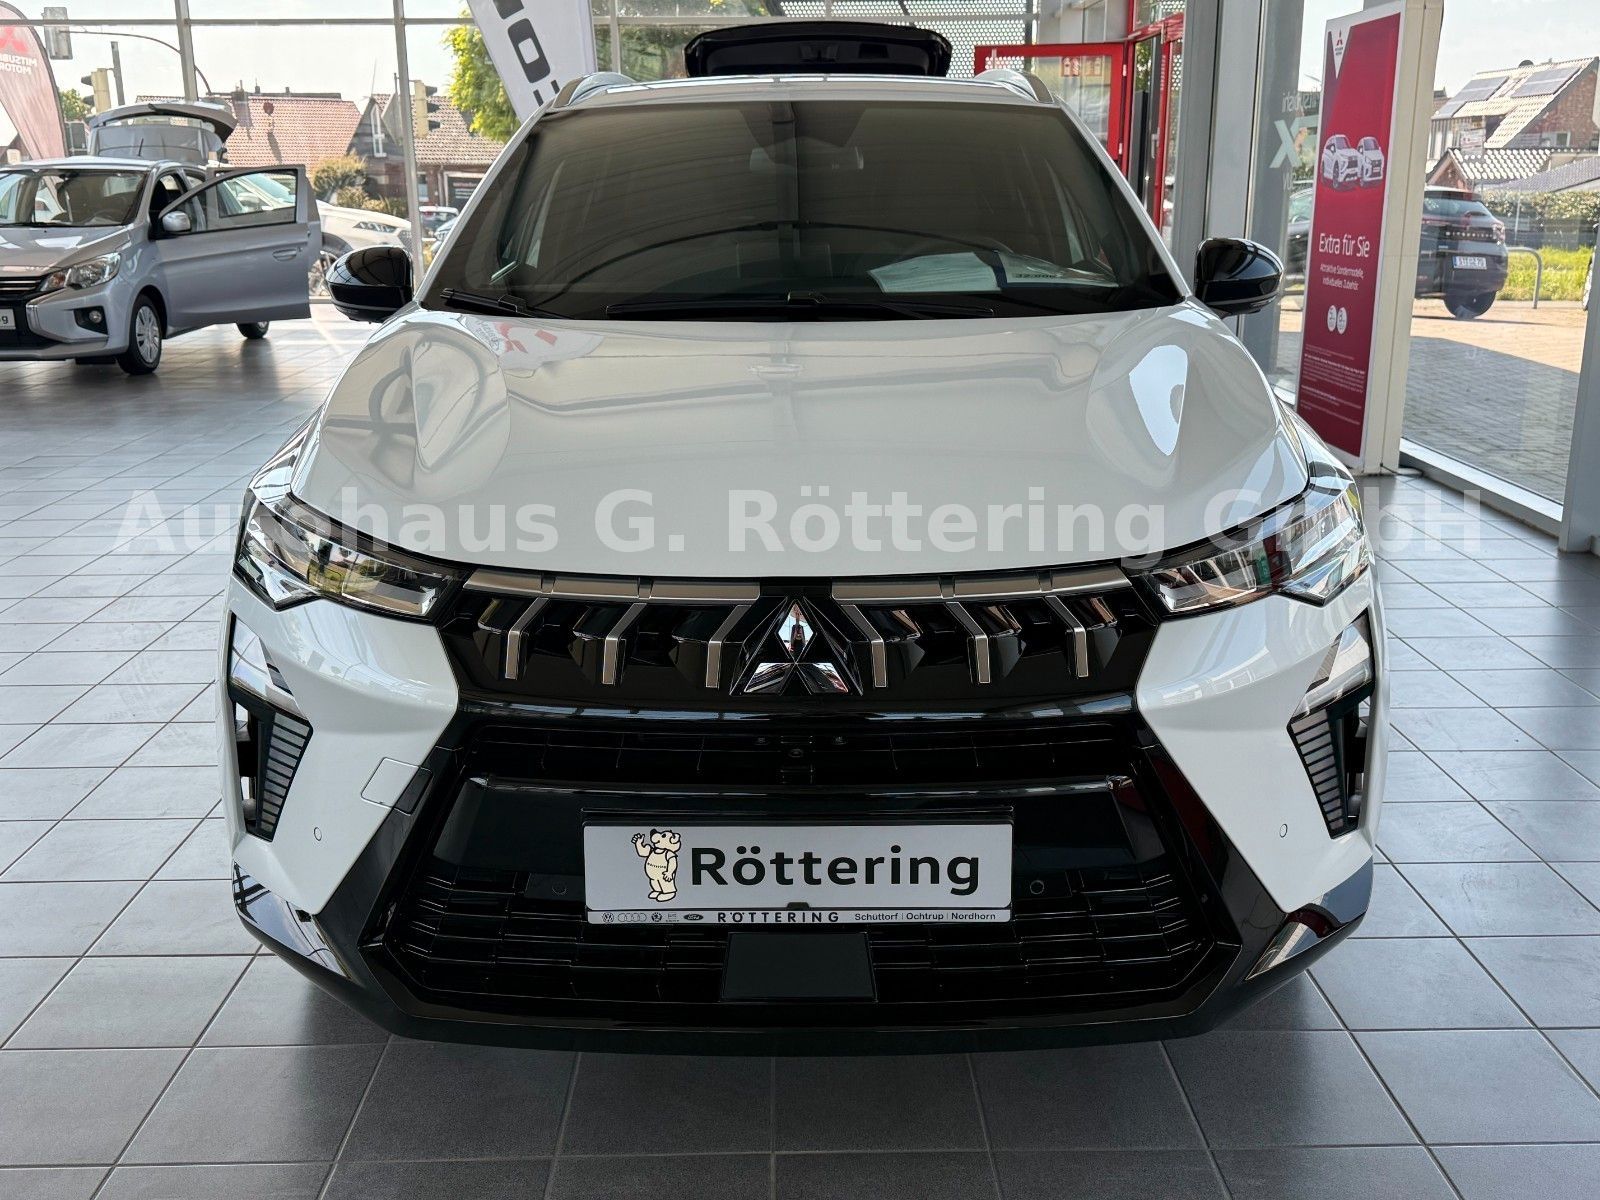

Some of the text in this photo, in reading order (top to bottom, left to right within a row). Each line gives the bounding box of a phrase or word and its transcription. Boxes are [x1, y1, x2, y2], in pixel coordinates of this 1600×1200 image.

[1319, 232, 1370, 258] Extra für Sie
[691, 845, 979, 895] Röttering
[717, 911, 839, 923] RÖTTERING
[905, 911, 945, 922] Ochtrup
[951, 911, 996, 920] Nordhorn
